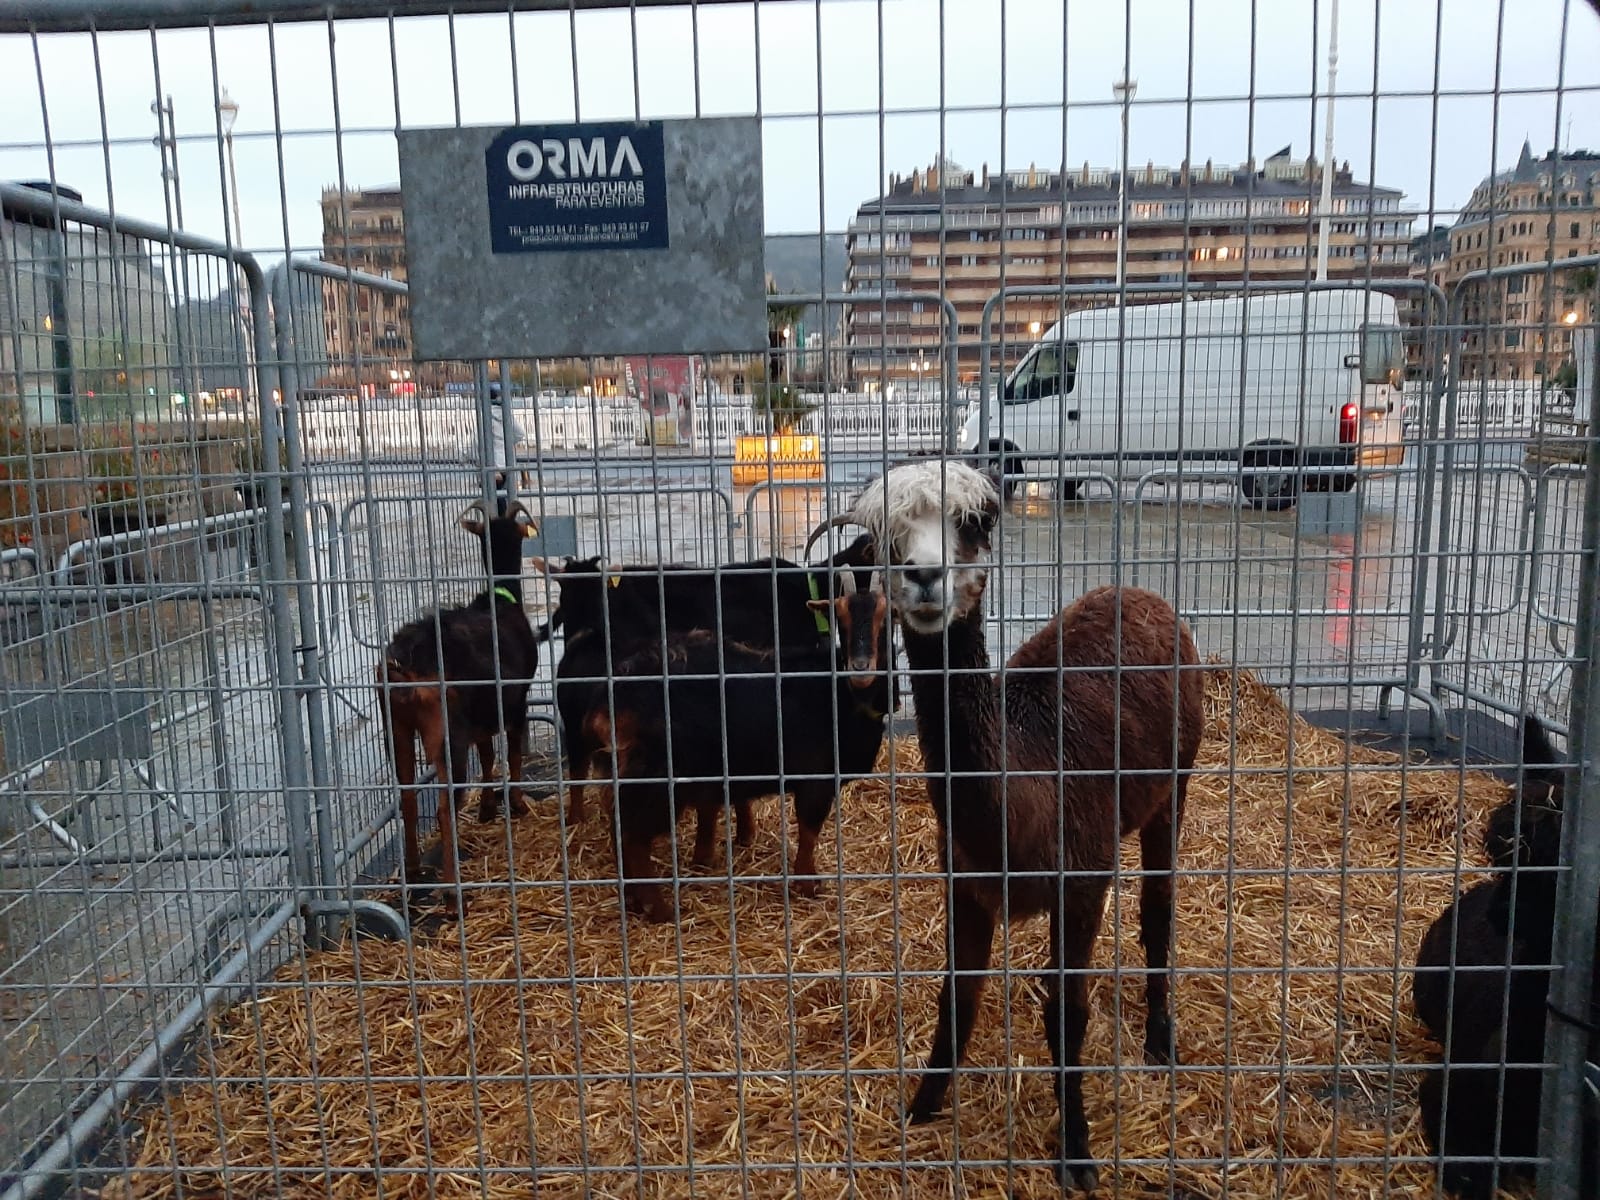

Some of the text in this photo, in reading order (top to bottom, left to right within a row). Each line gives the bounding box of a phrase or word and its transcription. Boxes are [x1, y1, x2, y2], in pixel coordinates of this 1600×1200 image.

[507, 136, 643, 181] ORMA
[509, 180, 645, 199] INFRAESTRUCTURAS
[555, 193, 645, 209] PARA EVENTOS
